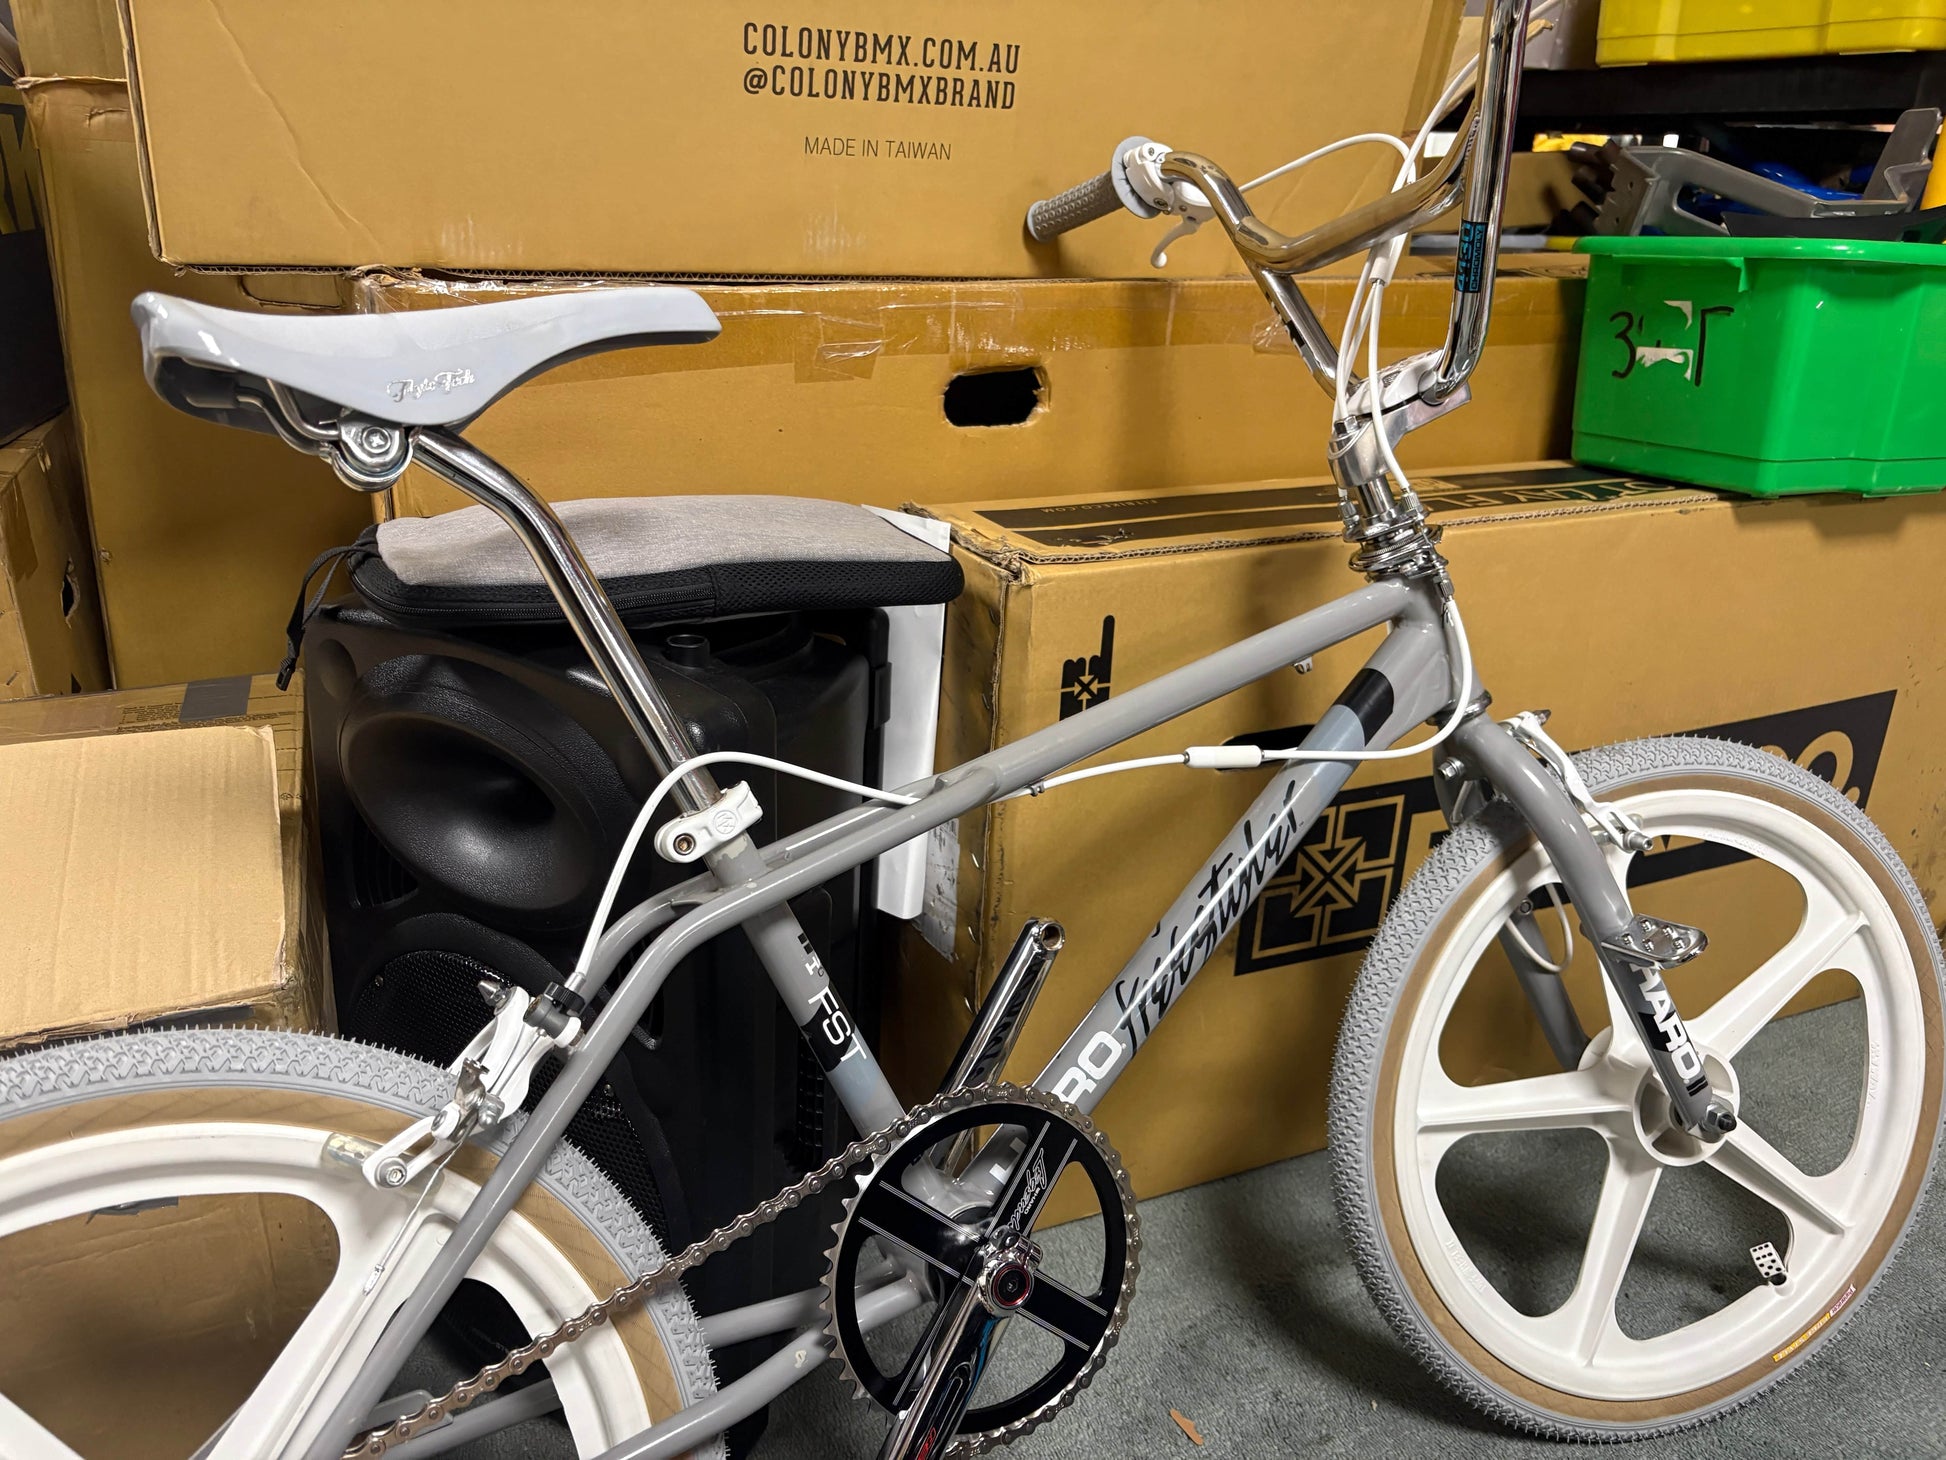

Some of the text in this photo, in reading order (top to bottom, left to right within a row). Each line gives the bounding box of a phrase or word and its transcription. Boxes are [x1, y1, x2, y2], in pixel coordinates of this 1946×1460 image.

[743, 22, 1020, 74] COLONYBMX.COM.AU
[743, 65, 1016, 110] @COLONYBMXBRAND
[804, 136, 952, 160] MADE IN TAIWAN
[1470, 228, 1484, 290] CHROMOLY
[808, 986, 867, 1062] FST
